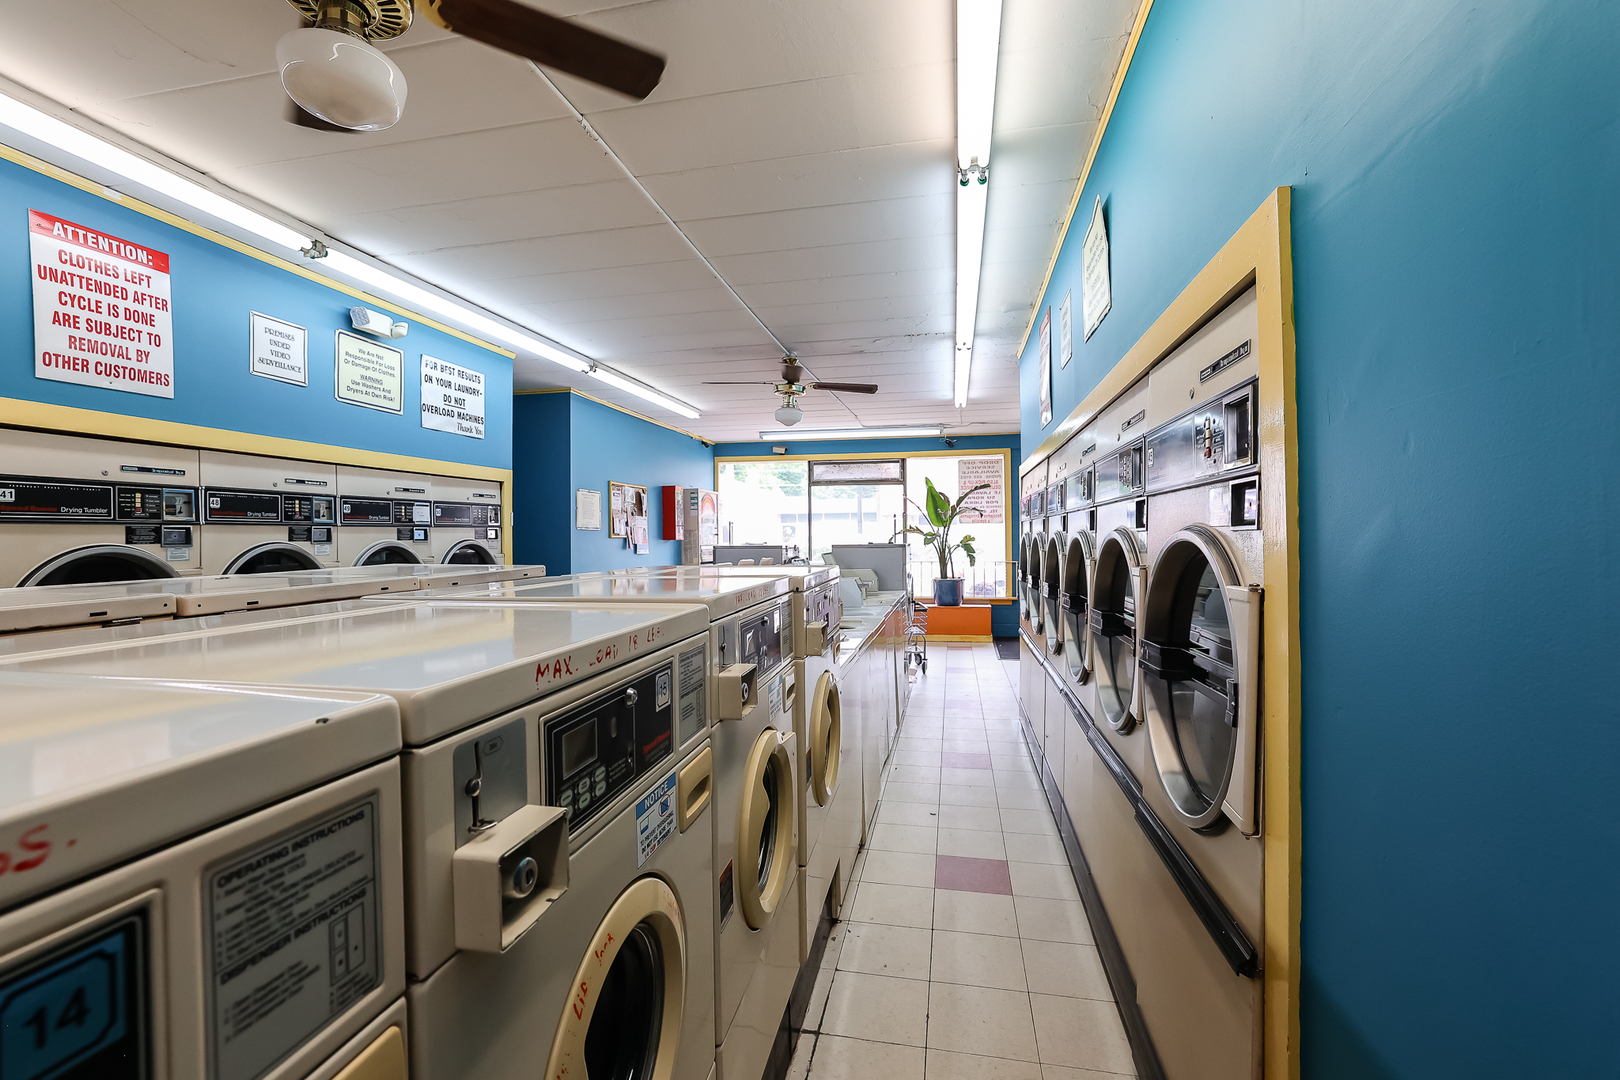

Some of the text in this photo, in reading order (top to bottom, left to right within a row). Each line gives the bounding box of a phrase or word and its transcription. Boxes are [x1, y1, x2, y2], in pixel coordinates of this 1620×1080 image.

[53, 222, 153, 266] ATTENTION:
[59, 249, 151, 289] CLOTHES LEFT
[38, 265, 168, 312] UNATTENDED AFTER
[59, 291, 156, 328] CYCLE IS DONE
[52, 311, 161, 348] ARE SUBJECT TO
[265, 327, 295, 341] PREMISES
[69, 335, 150, 364] REMOVAL BY
[270, 339, 291, 350] UNDER
[270, 350, 291, 360] VIDEO
[43, 352, 170, 387] OTHER CUSTOMERS
[346, 351, 375, 365] Responsible
[352, 361, 371, 371] Damage
[360, 374, 383, 386] WARNING
[424, 374, 433, 384] ON
[436, 377, 452, 389] YOUR
[425, 360, 481, 384] FOR BEST RESULTS
[347, 386, 363, 395] Dryers
[361, 382, 381, 391] Washers
[444, 394, 466, 407] DO NOT
[422, 403, 484, 425] OVERLOAD MACHINES
[457, 422, 474, 434] Thank
[535, 654, 579, 690] MAX.
[628, 634, 639, 653] 18
[659, 681, 667, 698] 15
[644, 780, 669, 810] NOTICE
[217, 810, 365, 888] OPERATING INSTRUCTIONS
[220, 933, 292, 986] DISPENSER
[294, 888, 367, 939] INSTRUCTIONS
[22, 986, 92, 1050] 14
